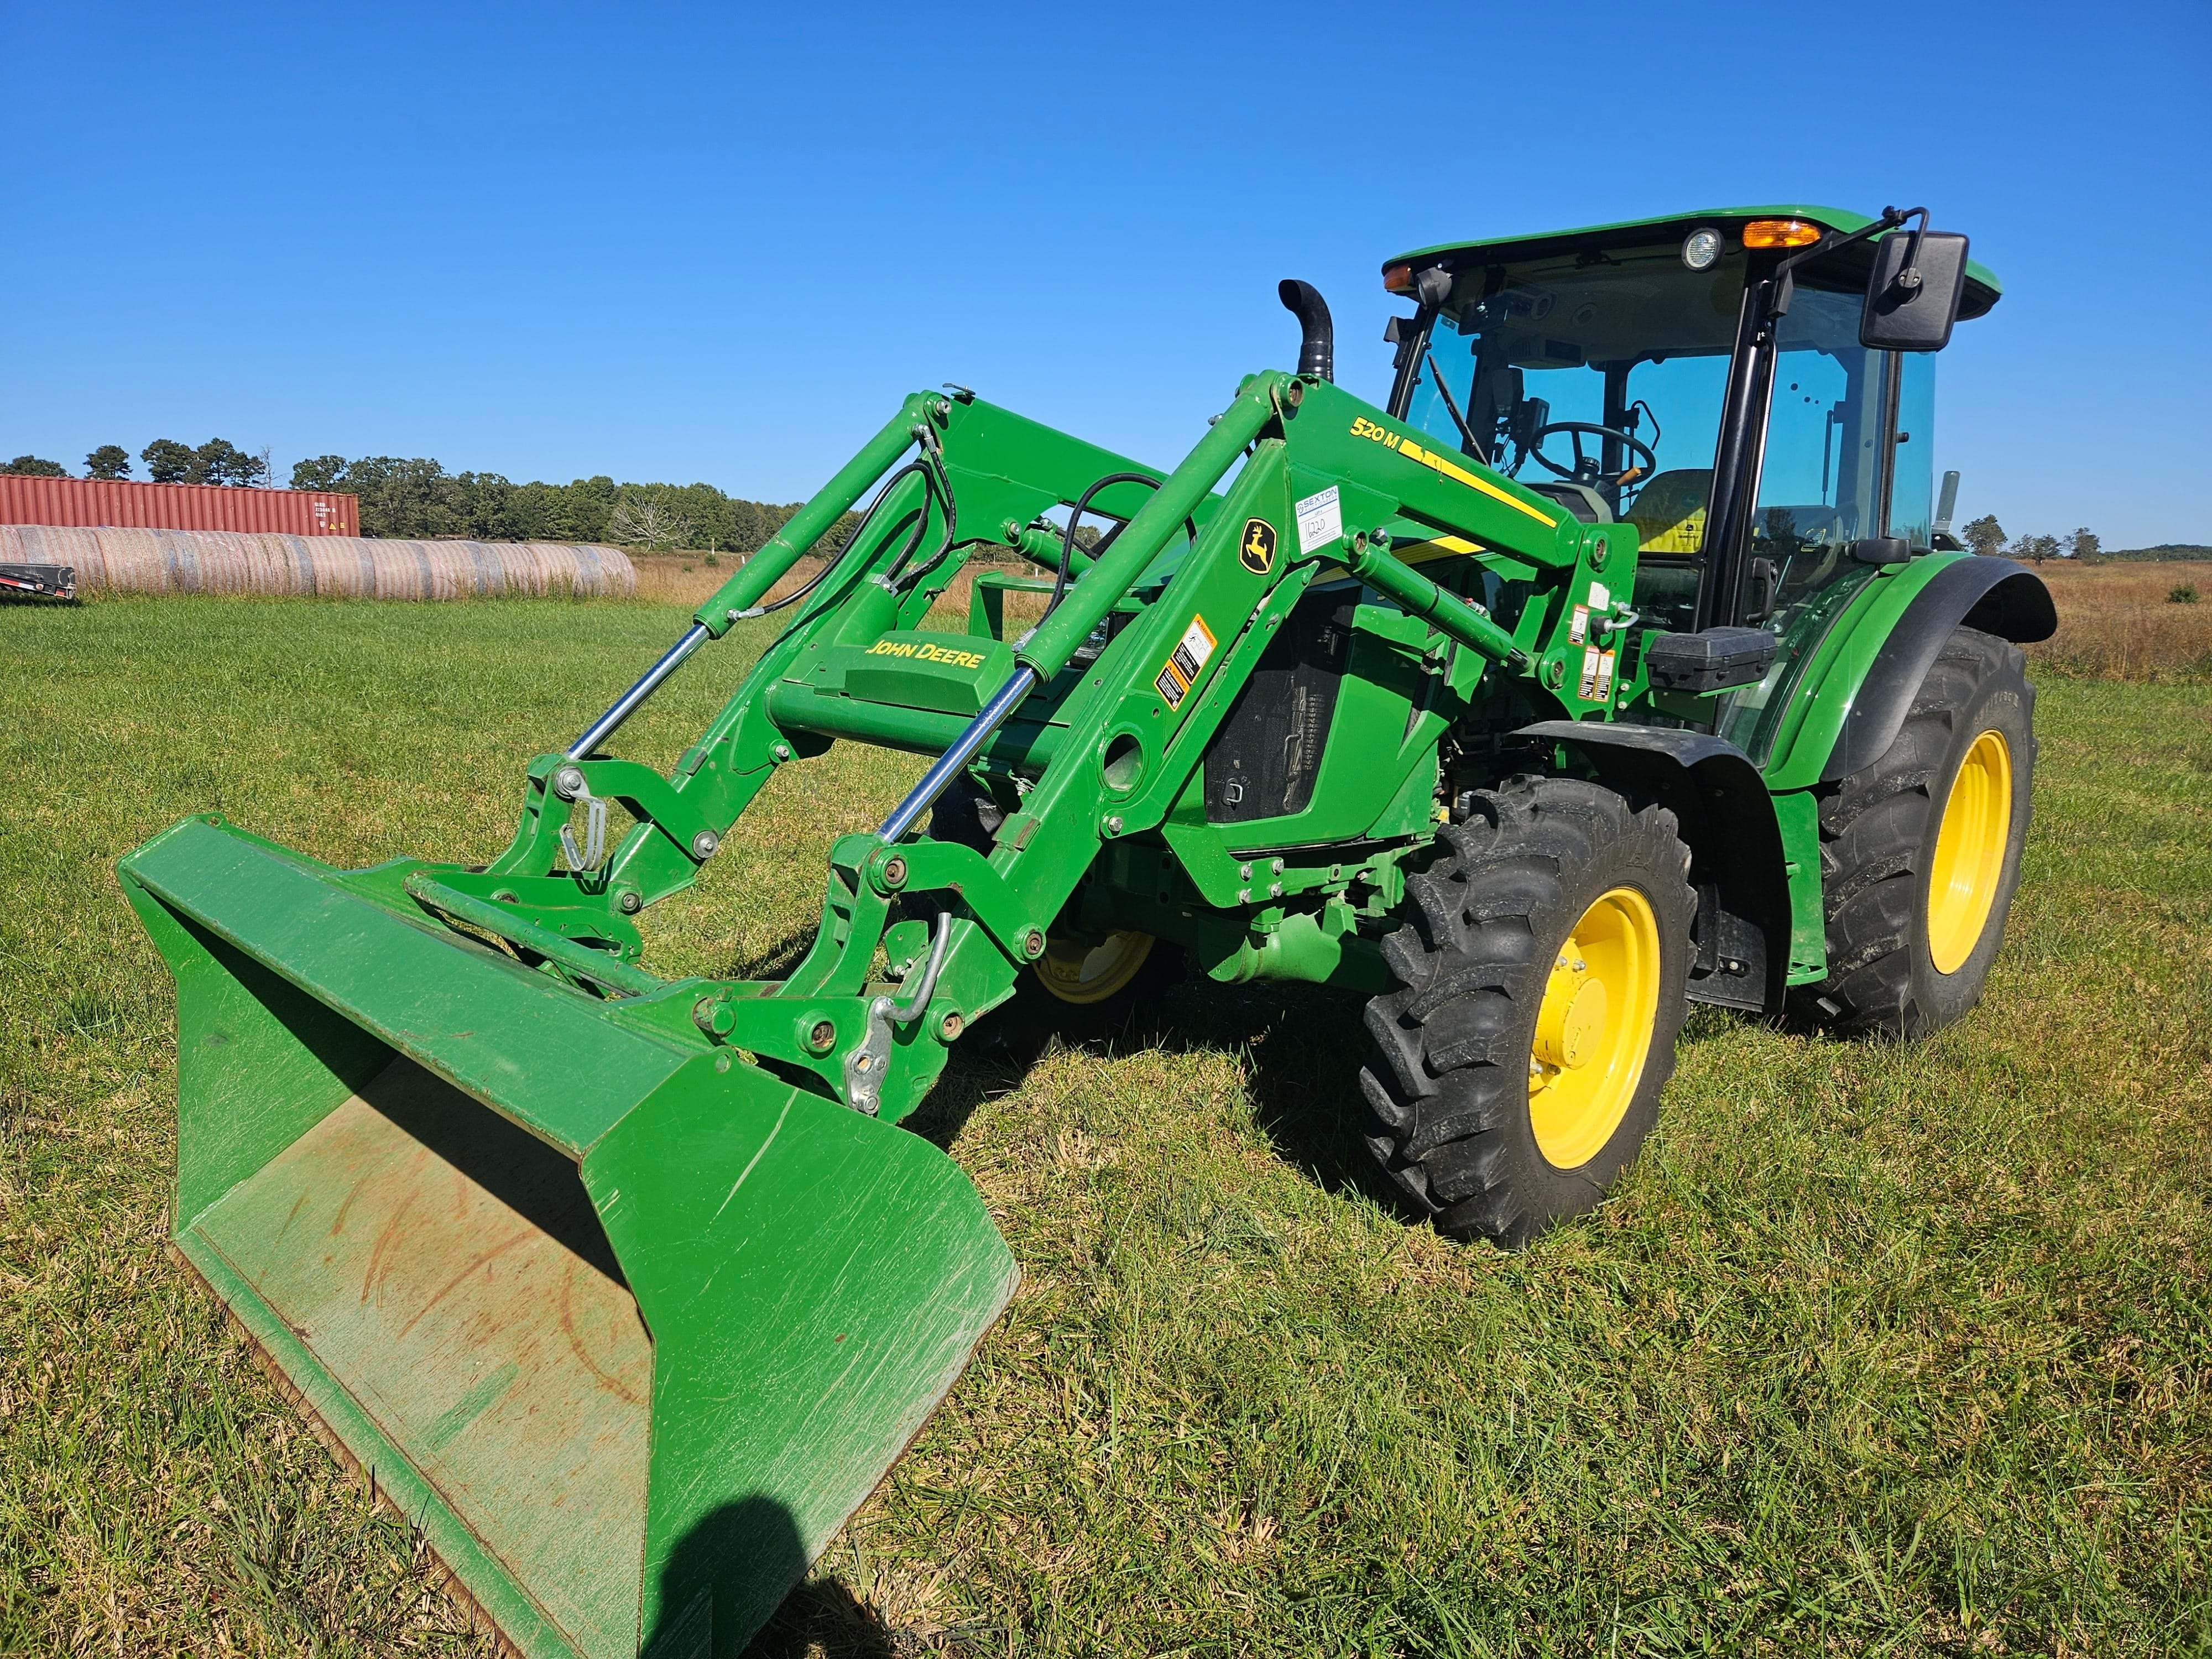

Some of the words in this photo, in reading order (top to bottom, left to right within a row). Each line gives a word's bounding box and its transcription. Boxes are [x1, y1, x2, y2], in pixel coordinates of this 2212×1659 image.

[1349, 416, 1385, 442] 520
[1383, 431, 1401, 450] M
[1304, 488, 1337, 508] SEXTON
[1305, 519, 1325, 540] 16220
[1200, 623, 1214, 644] WARNING
[865, 639, 919, 658] JOHN
[914, 643, 987, 669] DEERE
